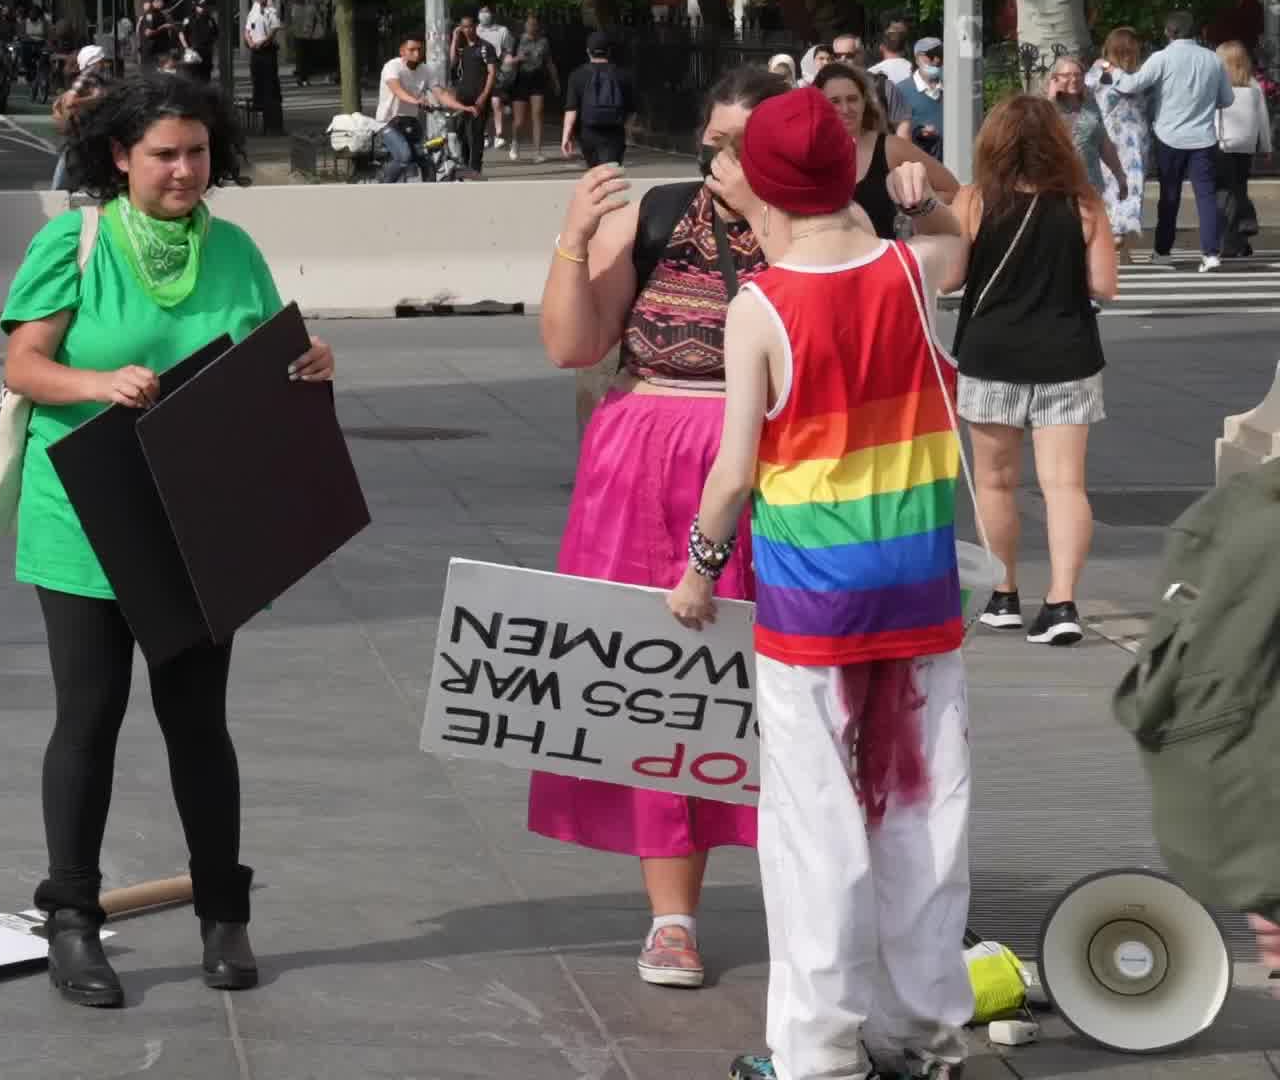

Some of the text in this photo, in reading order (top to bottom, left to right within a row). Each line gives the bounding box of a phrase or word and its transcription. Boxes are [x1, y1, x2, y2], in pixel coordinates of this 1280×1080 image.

[449, 605, 751, 689] WOMEN
[439, 652, 760, 740] LESS WAR
[441, 706, 760, 792] OP THE
